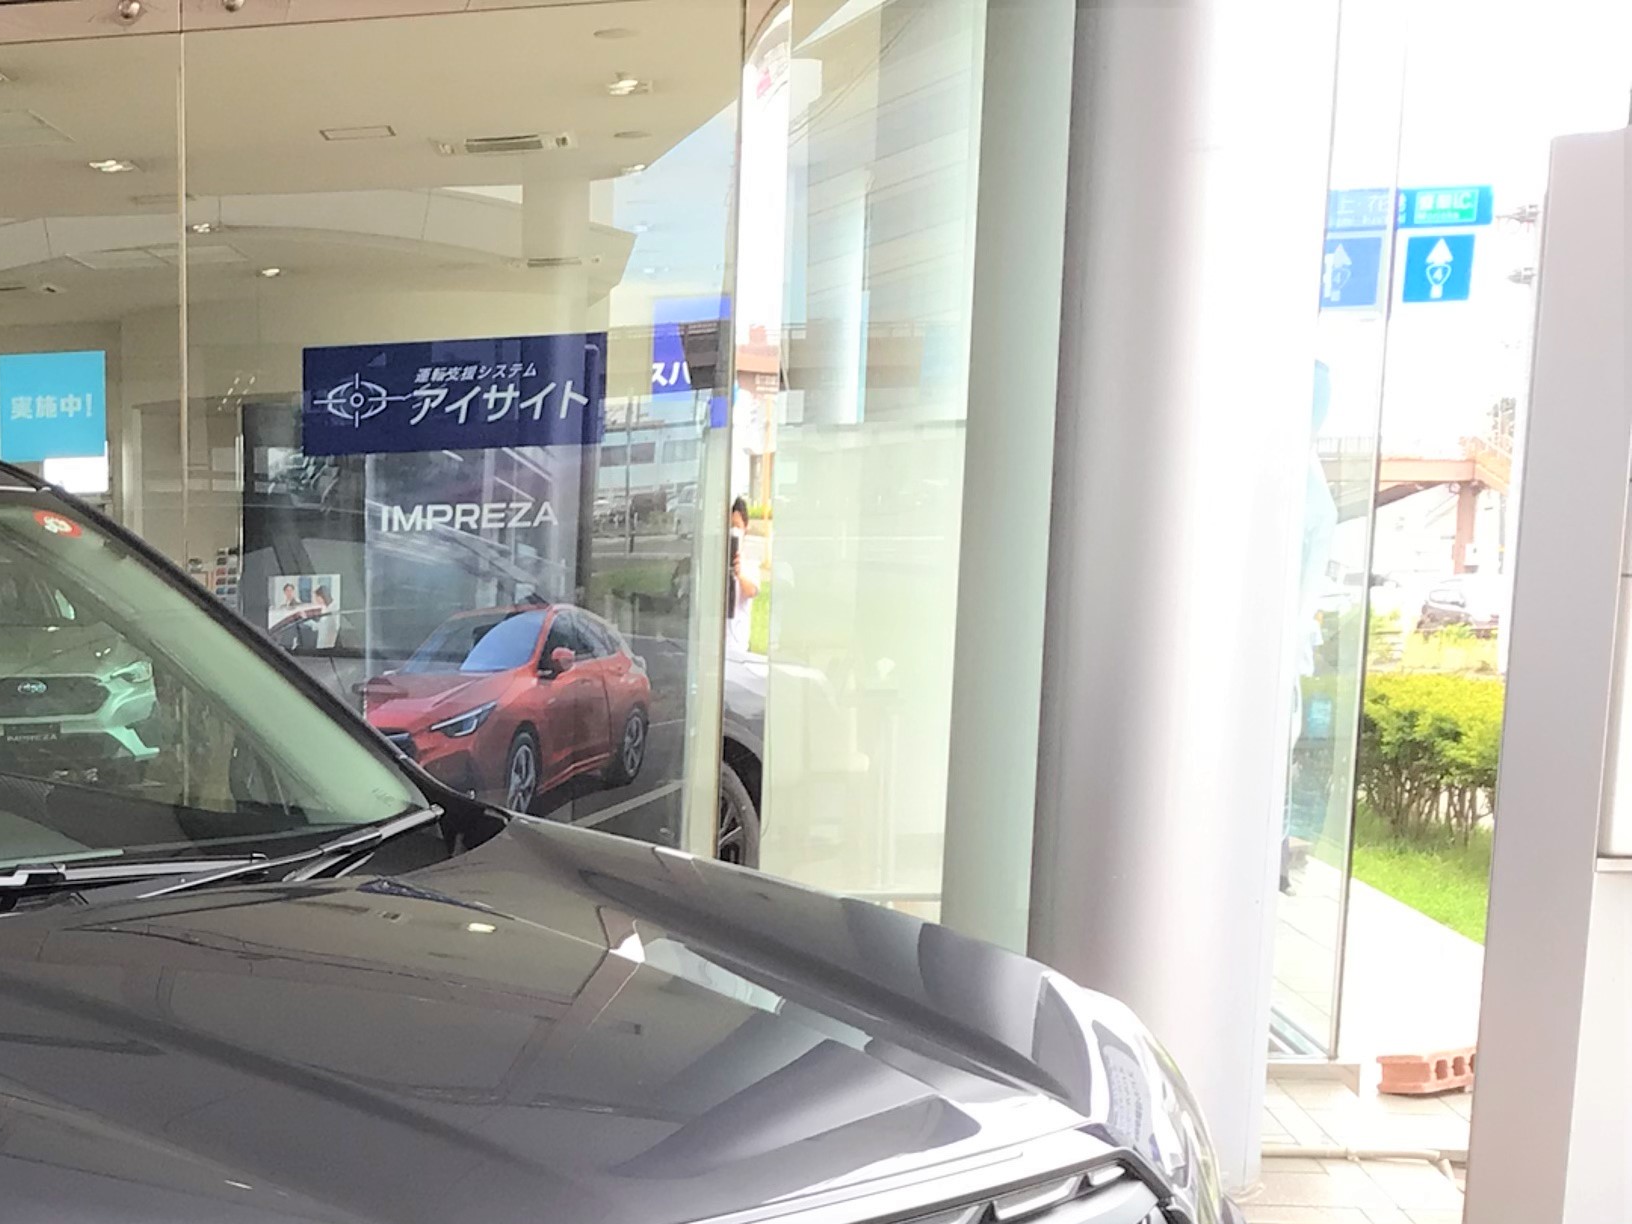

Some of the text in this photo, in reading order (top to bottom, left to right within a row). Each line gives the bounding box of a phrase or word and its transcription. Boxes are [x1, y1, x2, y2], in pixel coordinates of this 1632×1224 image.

[414, 363, 537, 384] 運転支援システム
[410, 380, 589, 426] アイサイト
[381, 501, 559, 533] IMPREZA
